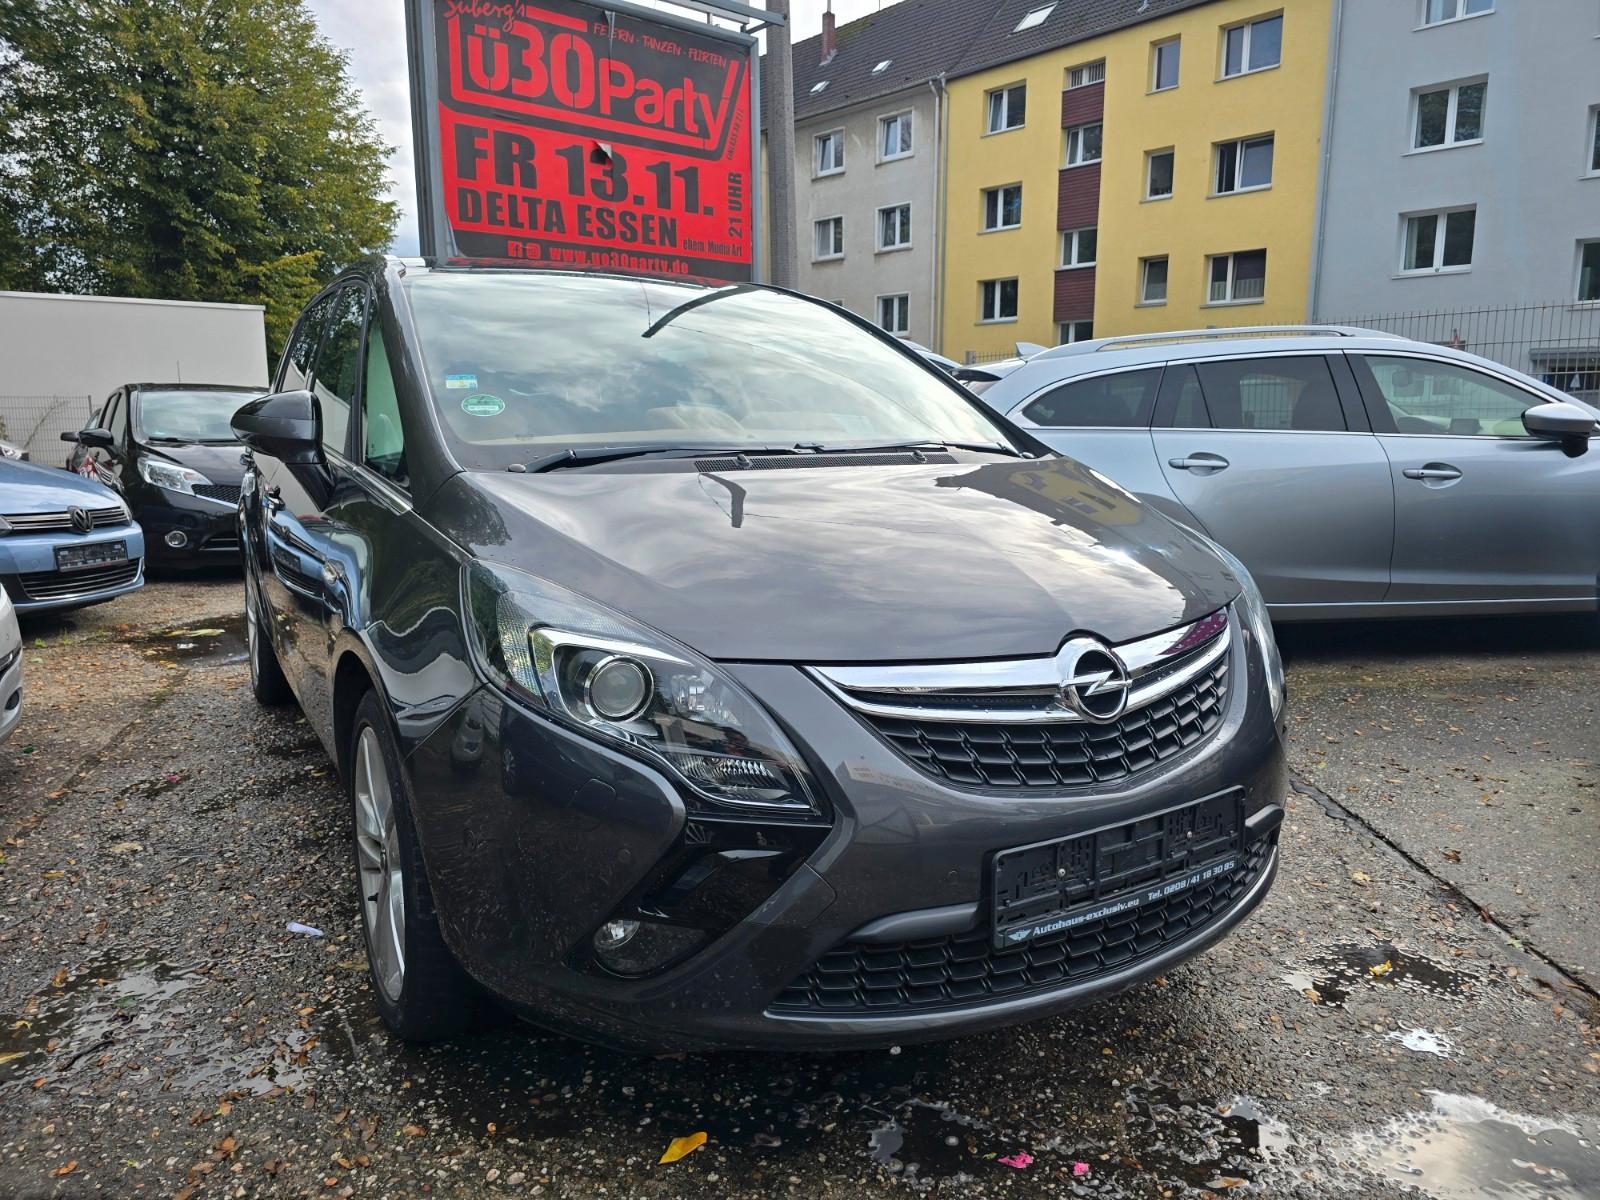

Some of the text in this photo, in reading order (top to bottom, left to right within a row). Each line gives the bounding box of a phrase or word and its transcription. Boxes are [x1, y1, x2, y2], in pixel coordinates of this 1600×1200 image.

[642, 35, 681, 56] TANZEN
[688, 48, 727, 68] FLIRTEN
[454, 123, 714, 216] FR 13.11.
[457, 187, 677, 248] DELTA ESSEN
[728, 171, 743, 239] 21 UHR
[1033, 899, 1140, 936] Autohaus-exclusiv.eu
[1148, 889, 1163, 901] Tel.
[1203, 870, 1212, 880] 18
[1212, 865, 1223, 876] 30
